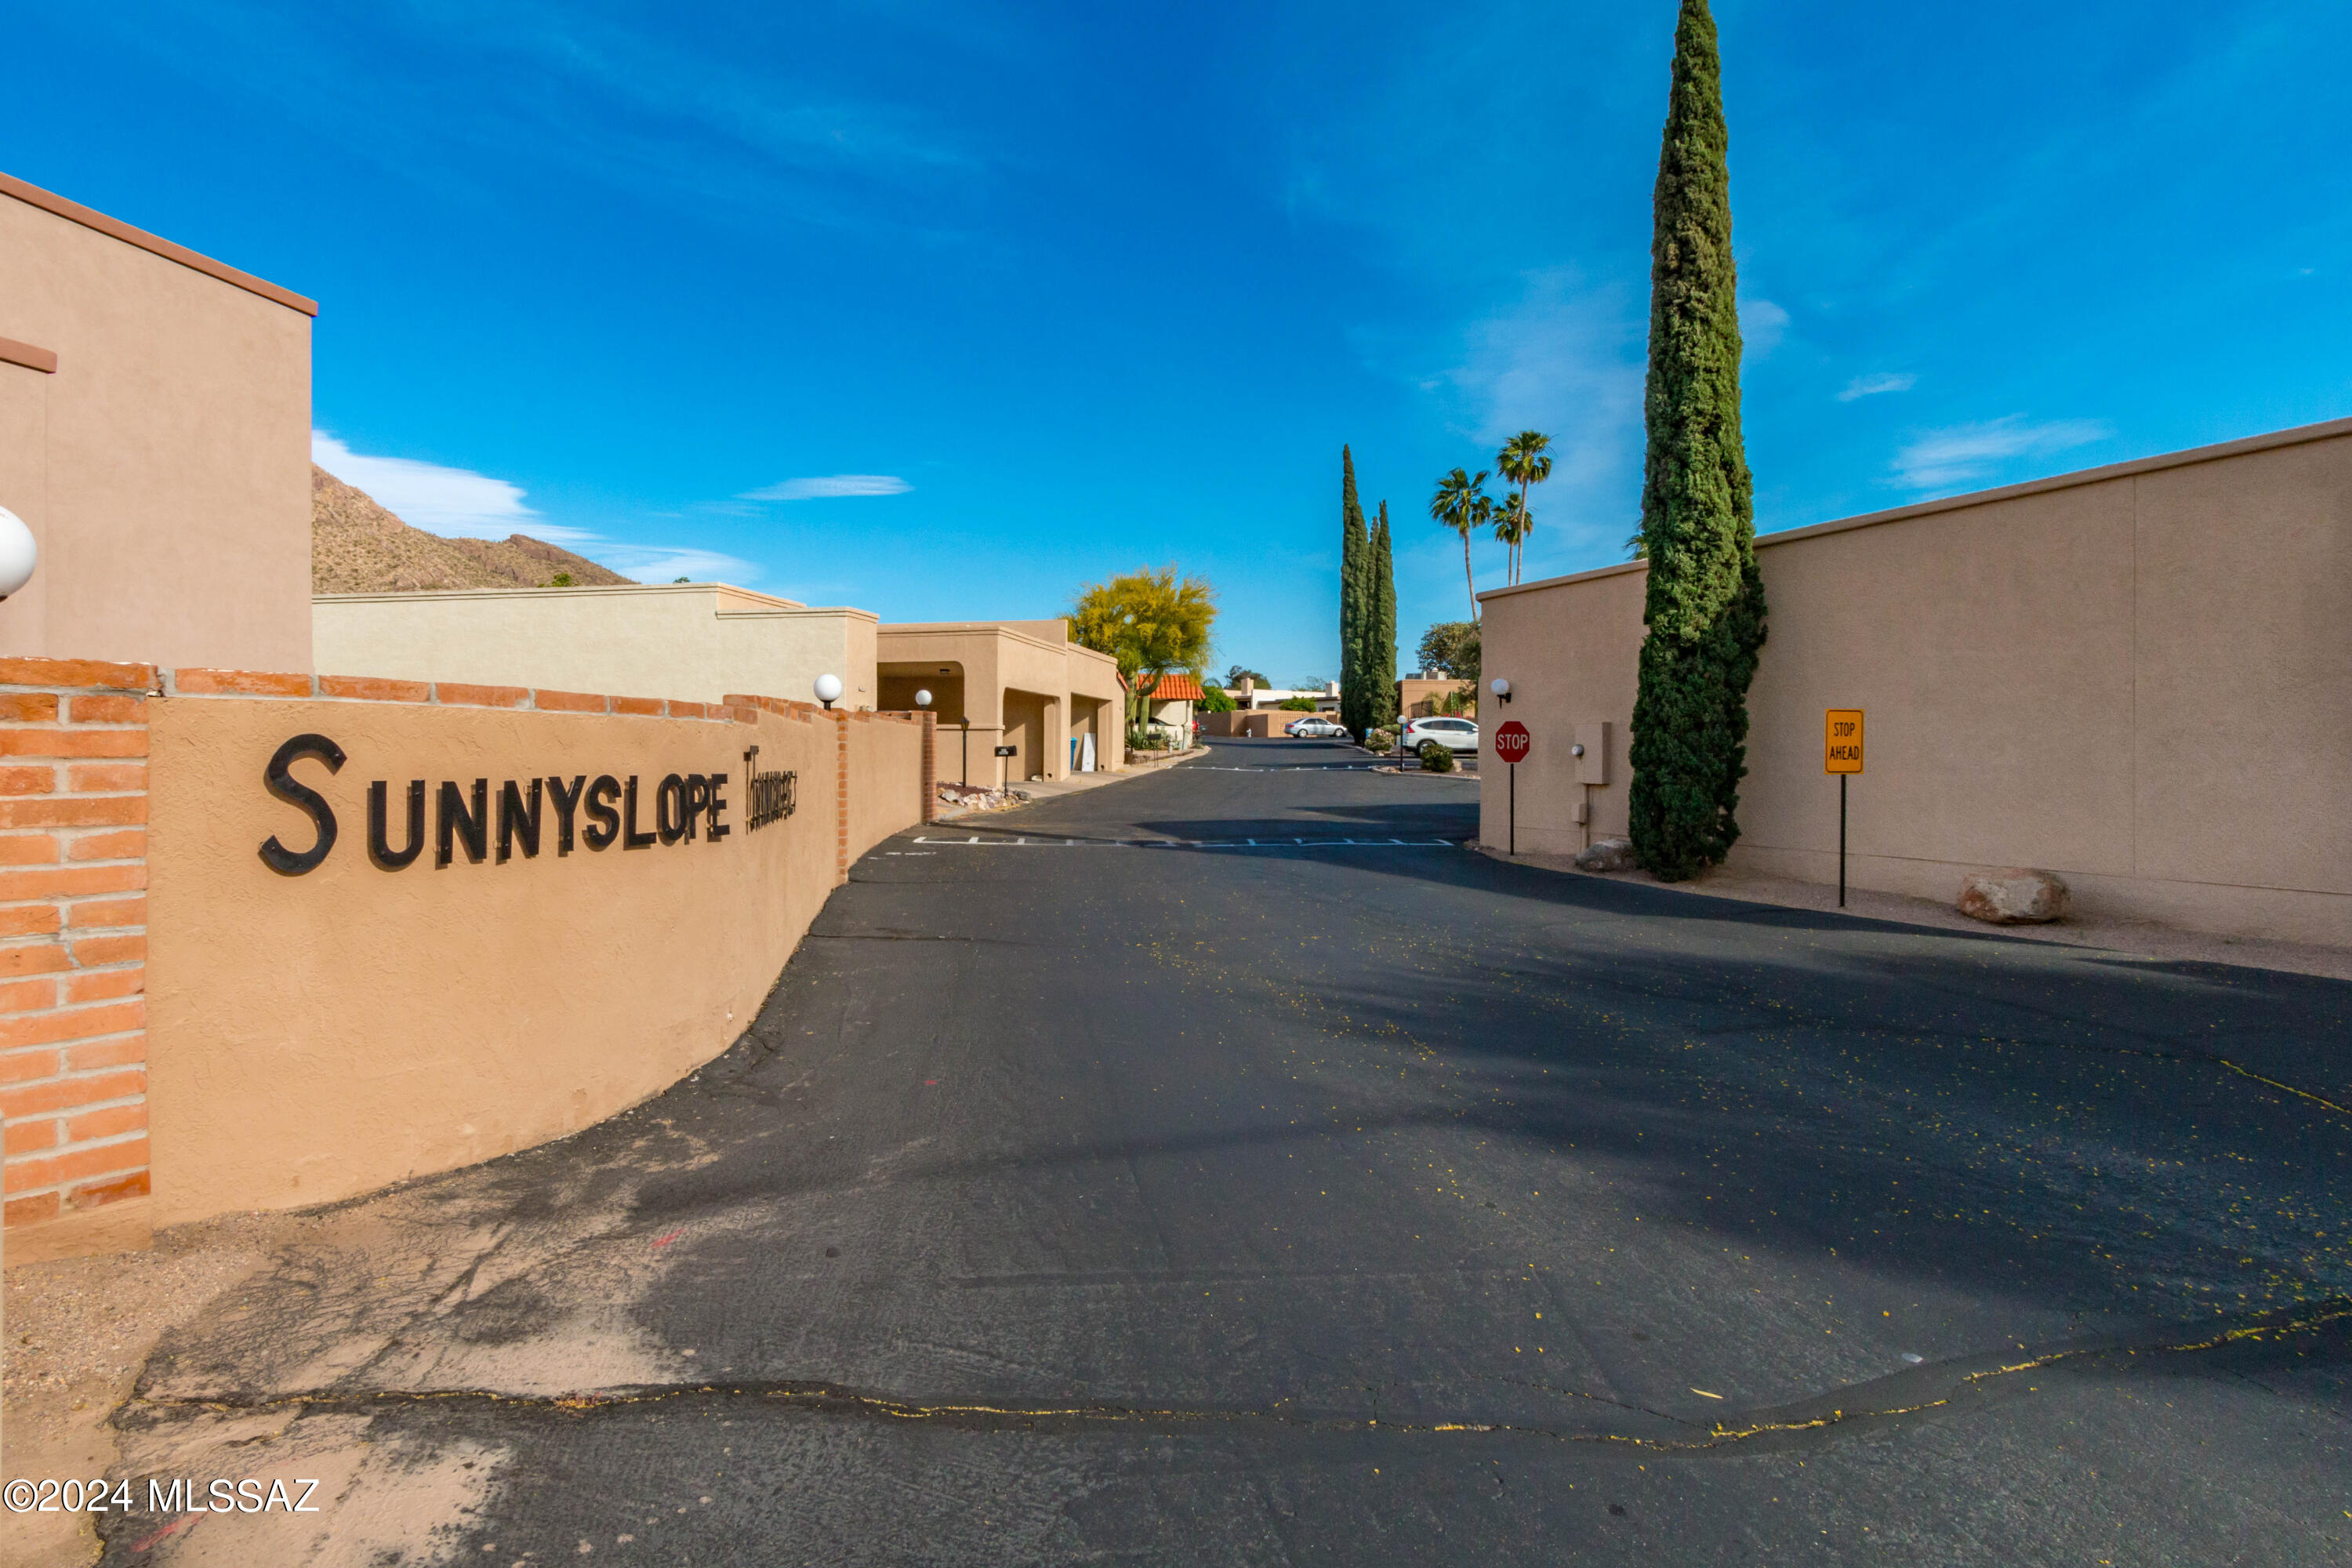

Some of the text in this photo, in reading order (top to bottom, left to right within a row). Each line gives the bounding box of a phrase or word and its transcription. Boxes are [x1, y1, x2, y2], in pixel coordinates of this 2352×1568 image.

[1834, 722, 1855, 737] STOP
[1497, 734, 1528, 750] STOP
[1829, 746, 1860, 760] AHEAD
[260, 733, 731, 875] SUNNYSLOPE
